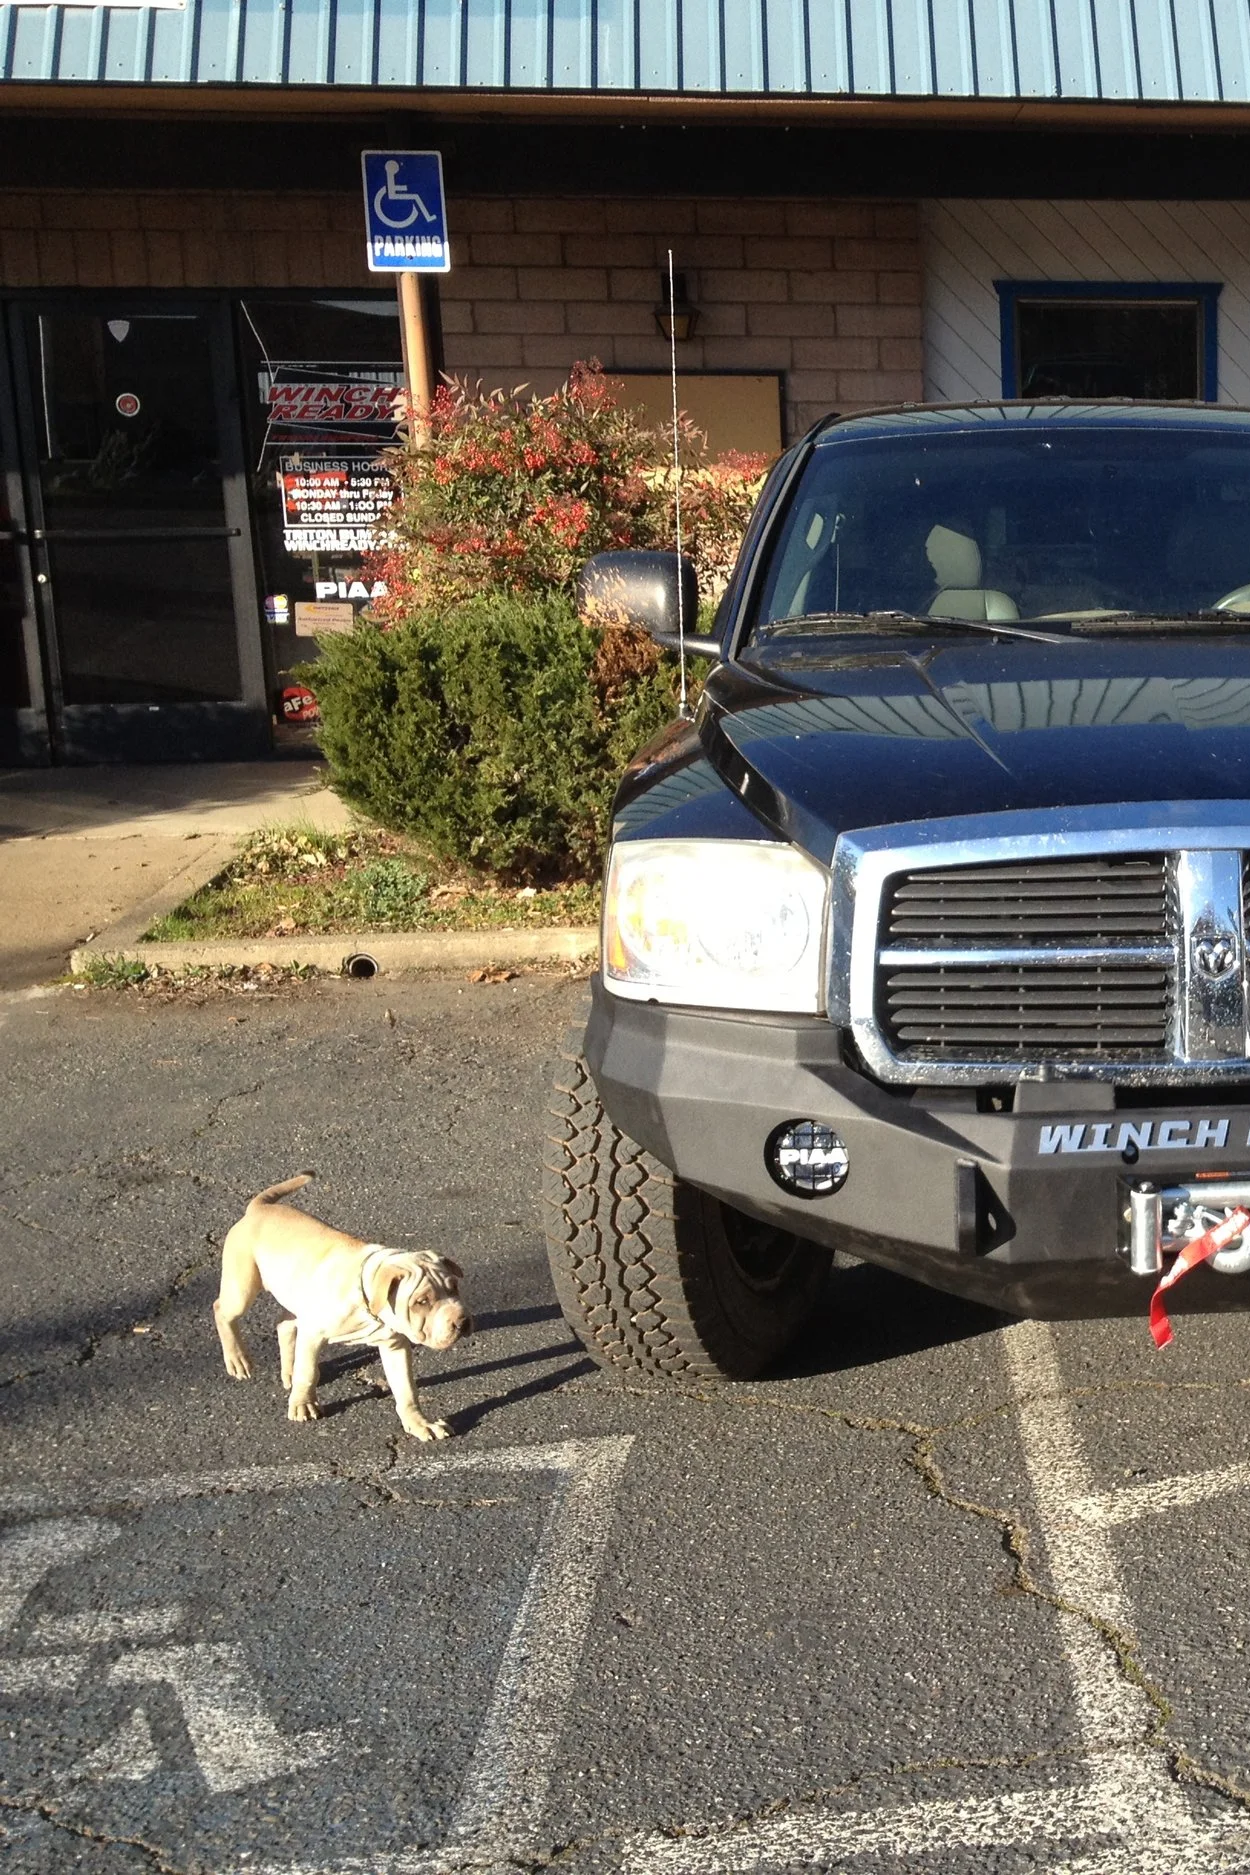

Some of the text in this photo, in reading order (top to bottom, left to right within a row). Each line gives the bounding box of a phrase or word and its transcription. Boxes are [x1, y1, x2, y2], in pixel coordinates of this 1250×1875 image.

[374, 235, 443, 257] PARKING
[267, 386, 402, 402] WINCH
[267, 403, 406, 421] READY
[285, 461, 389, 472] BUSINESS HOUR
[294, 477, 321, 487] 10:00
[323, 477, 340, 487] AM
[339, 489, 360, 499] thru
[324, 501, 341, 510] AM
[300, 513, 344, 522] CLOSED
[283, 529, 337, 540] TRITON
[315, 581, 388, 599] PIAA
[283, 695, 313, 712] aFe
[1038, 1118, 1230, 1154] WINCH
[779, 1147, 848, 1166] PIAA
